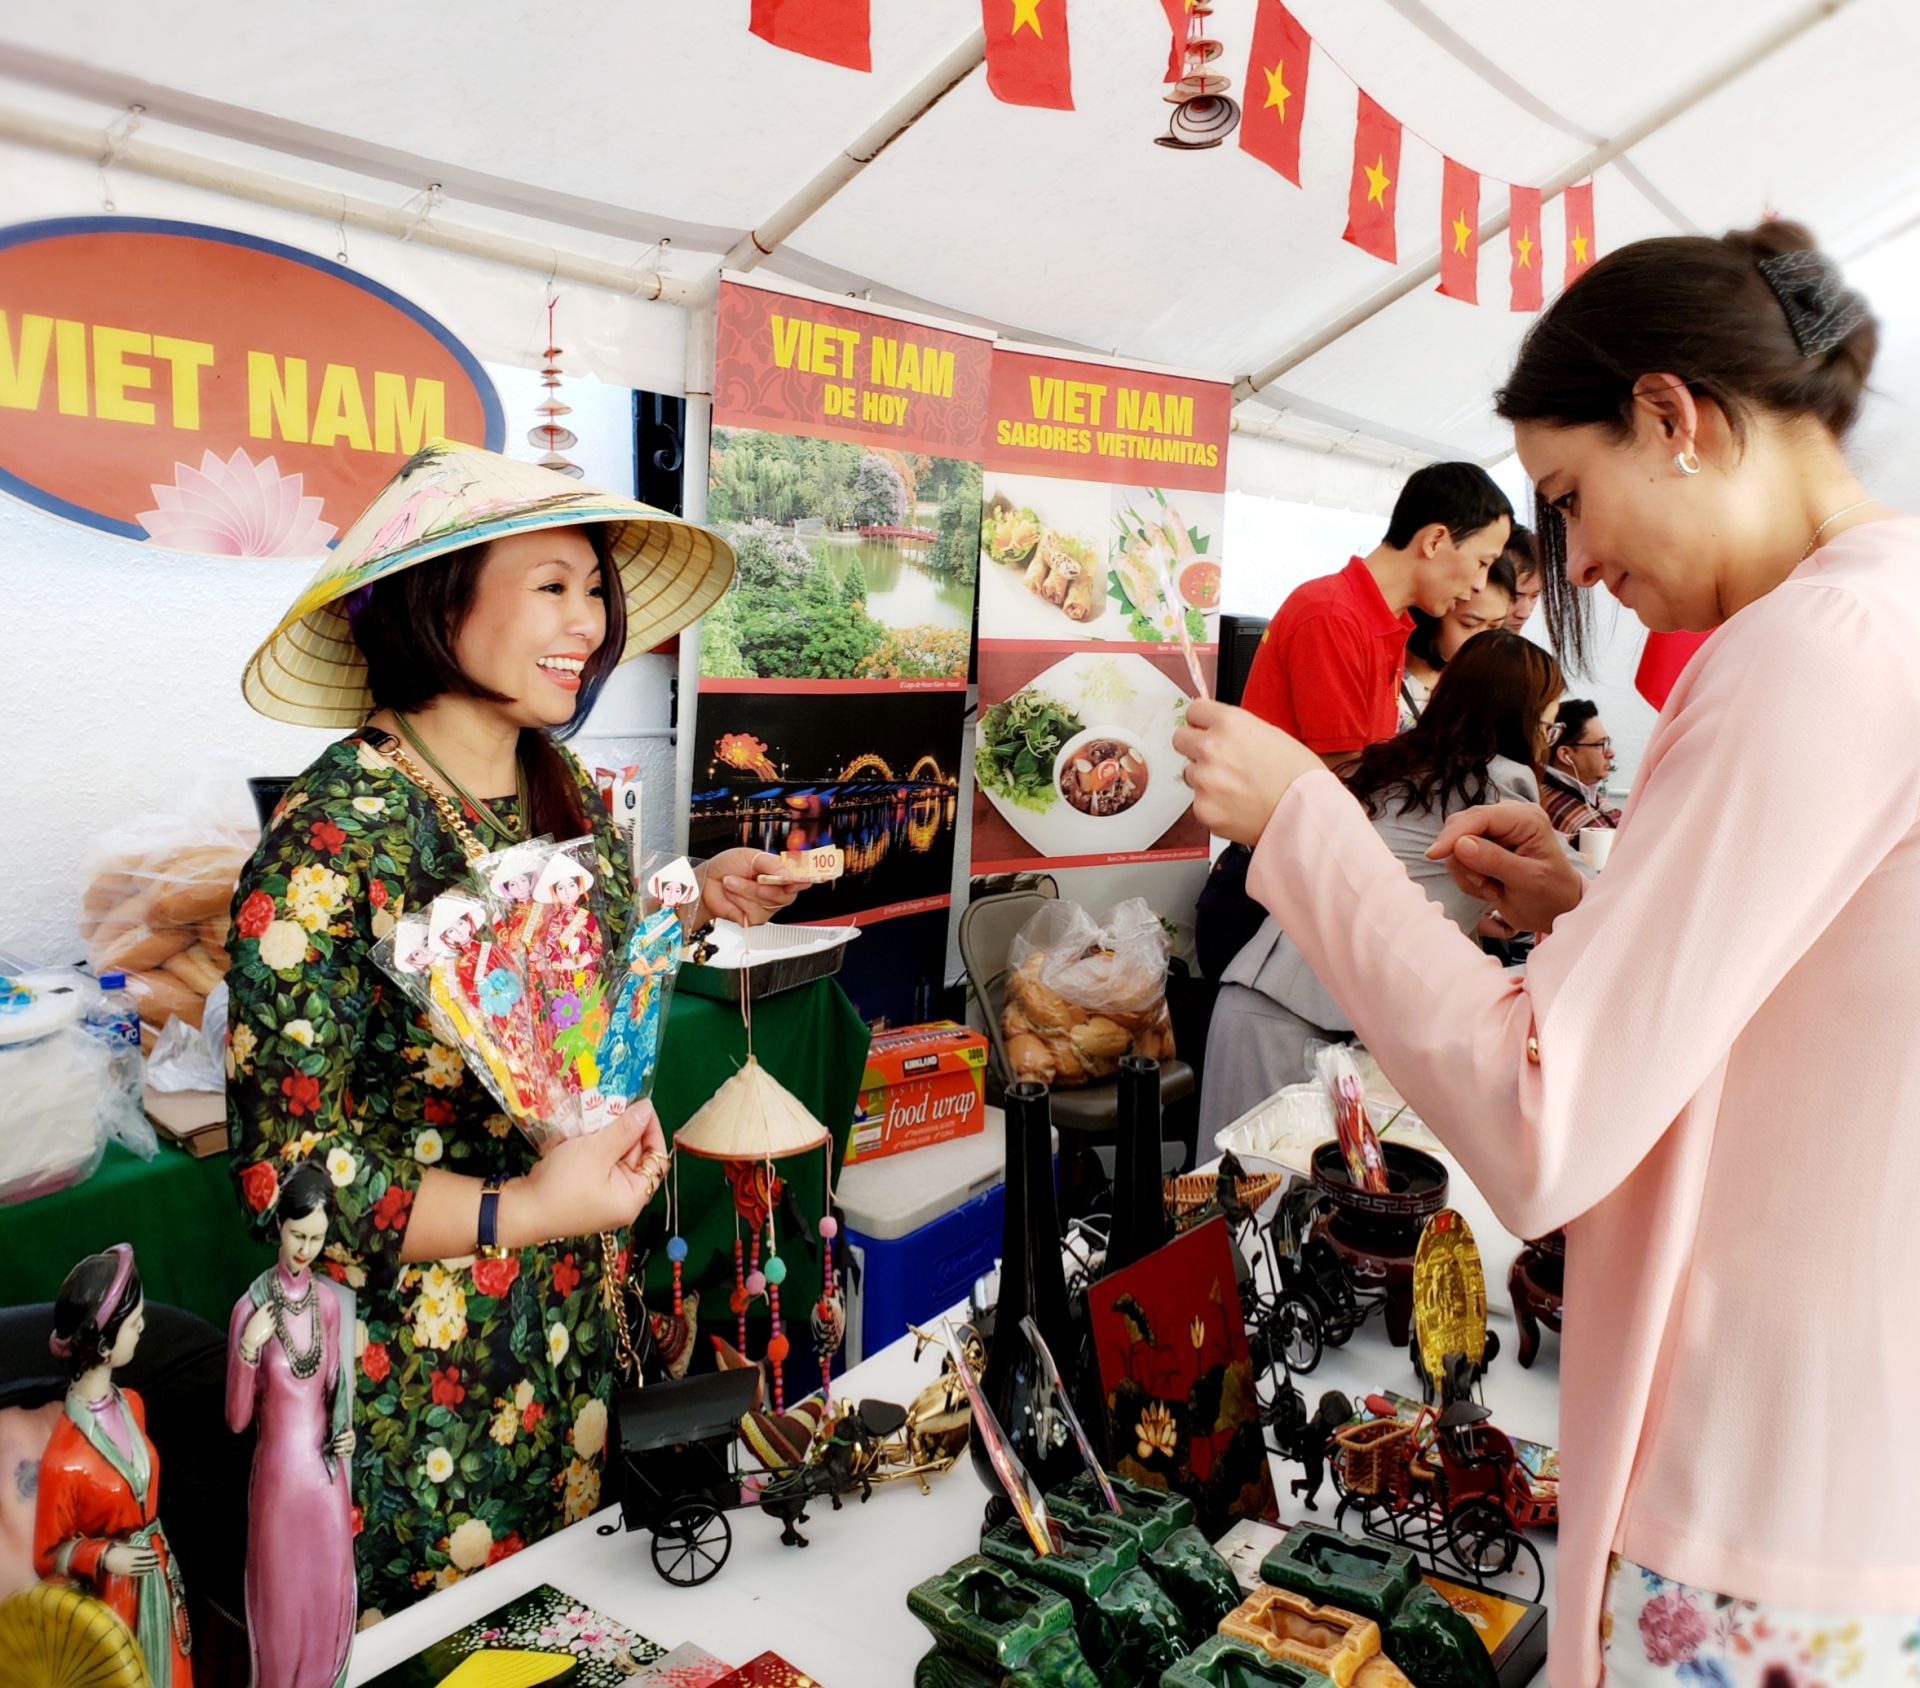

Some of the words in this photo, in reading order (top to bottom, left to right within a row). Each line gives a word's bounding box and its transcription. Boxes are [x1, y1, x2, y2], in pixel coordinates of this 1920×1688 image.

[771, 315, 860, 380] VIET
[871, 336, 955, 399] NAM
[0, 309, 214, 431] VIET
[248, 350, 445, 456] NAM
[824, 383, 855, 419] DE
[862, 390, 908, 427] HOY
[1029, 375, 1107, 426] VIET
[1116, 388, 1194, 437] NAM
[997, 419, 1092, 454] SABORES
[1096, 431, 1218, 468] VIETNAMITAS
[812, 854, 835, 868] 100
[904, 1055, 938, 1071] KIRKLAND
[868, 1079, 934, 1103] PLASTIC
[884, 1092, 929, 1141] food
[932, 1091, 976, 1123] wrap
